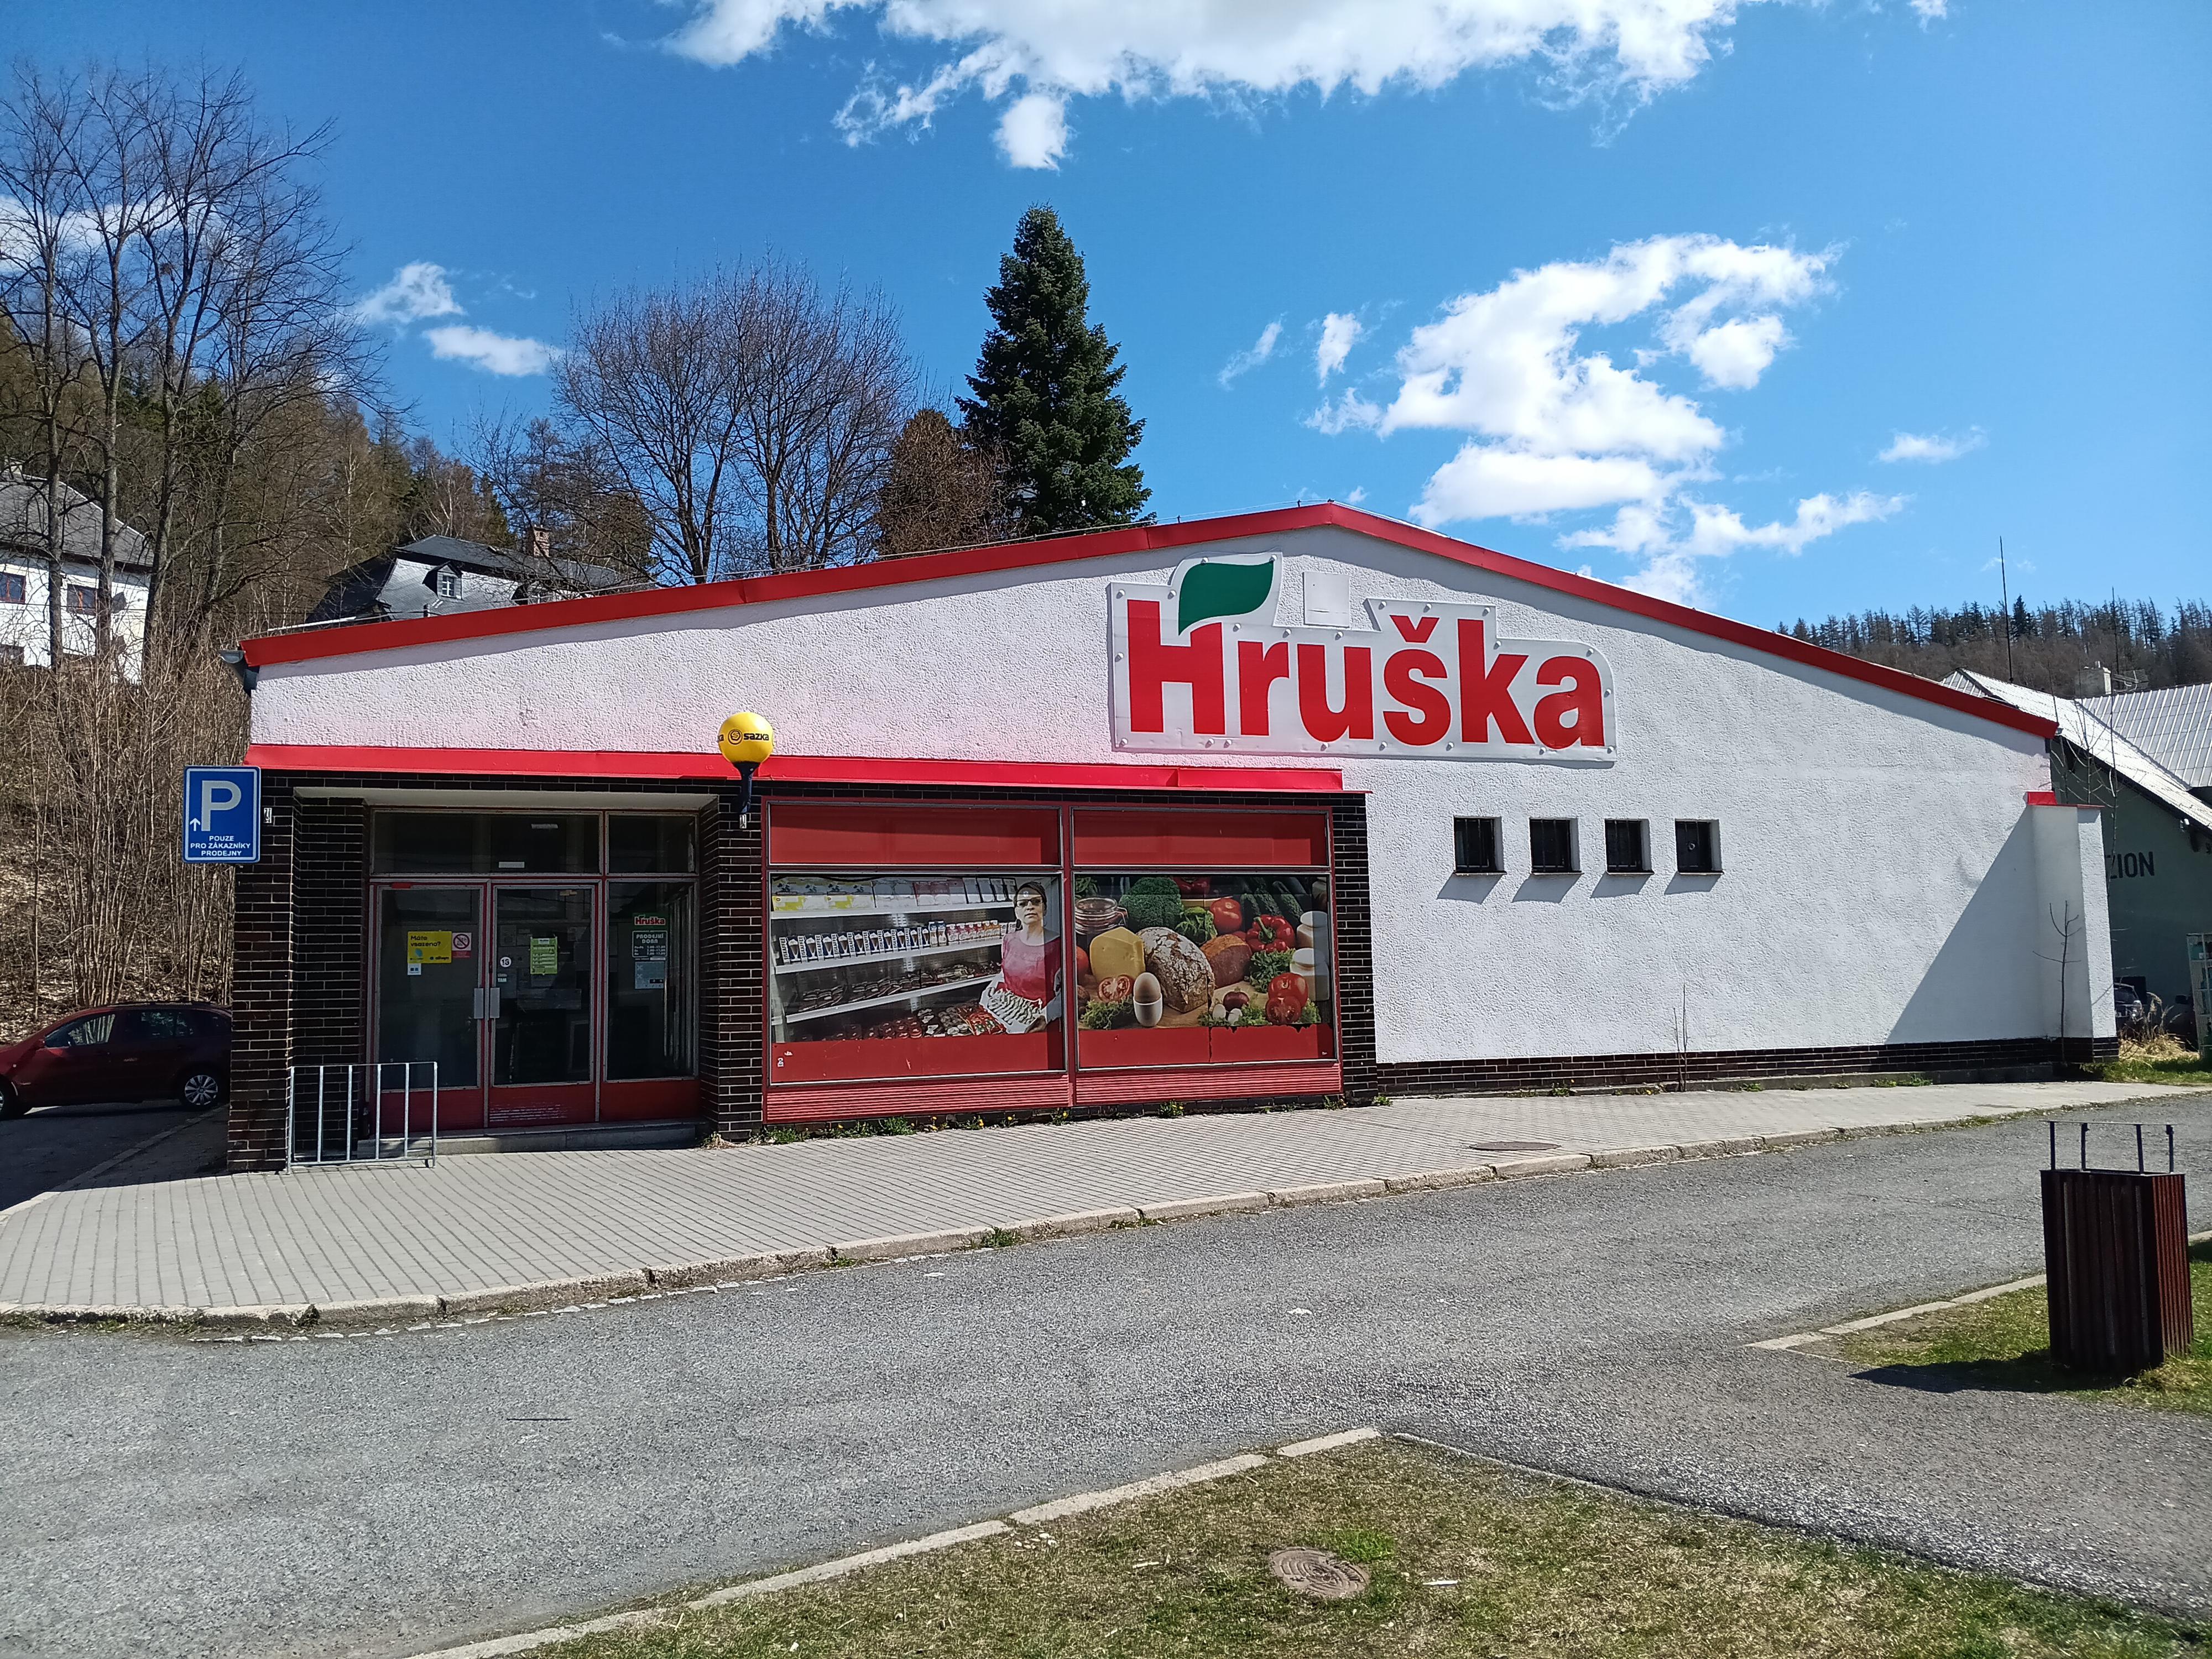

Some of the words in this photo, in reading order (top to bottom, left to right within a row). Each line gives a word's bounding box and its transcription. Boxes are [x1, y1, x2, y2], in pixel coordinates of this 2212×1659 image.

[1126, 599, 1606, 749] Hruška
[743, 733, 769, 741] sazka
[201, 780, 242, 832] P
